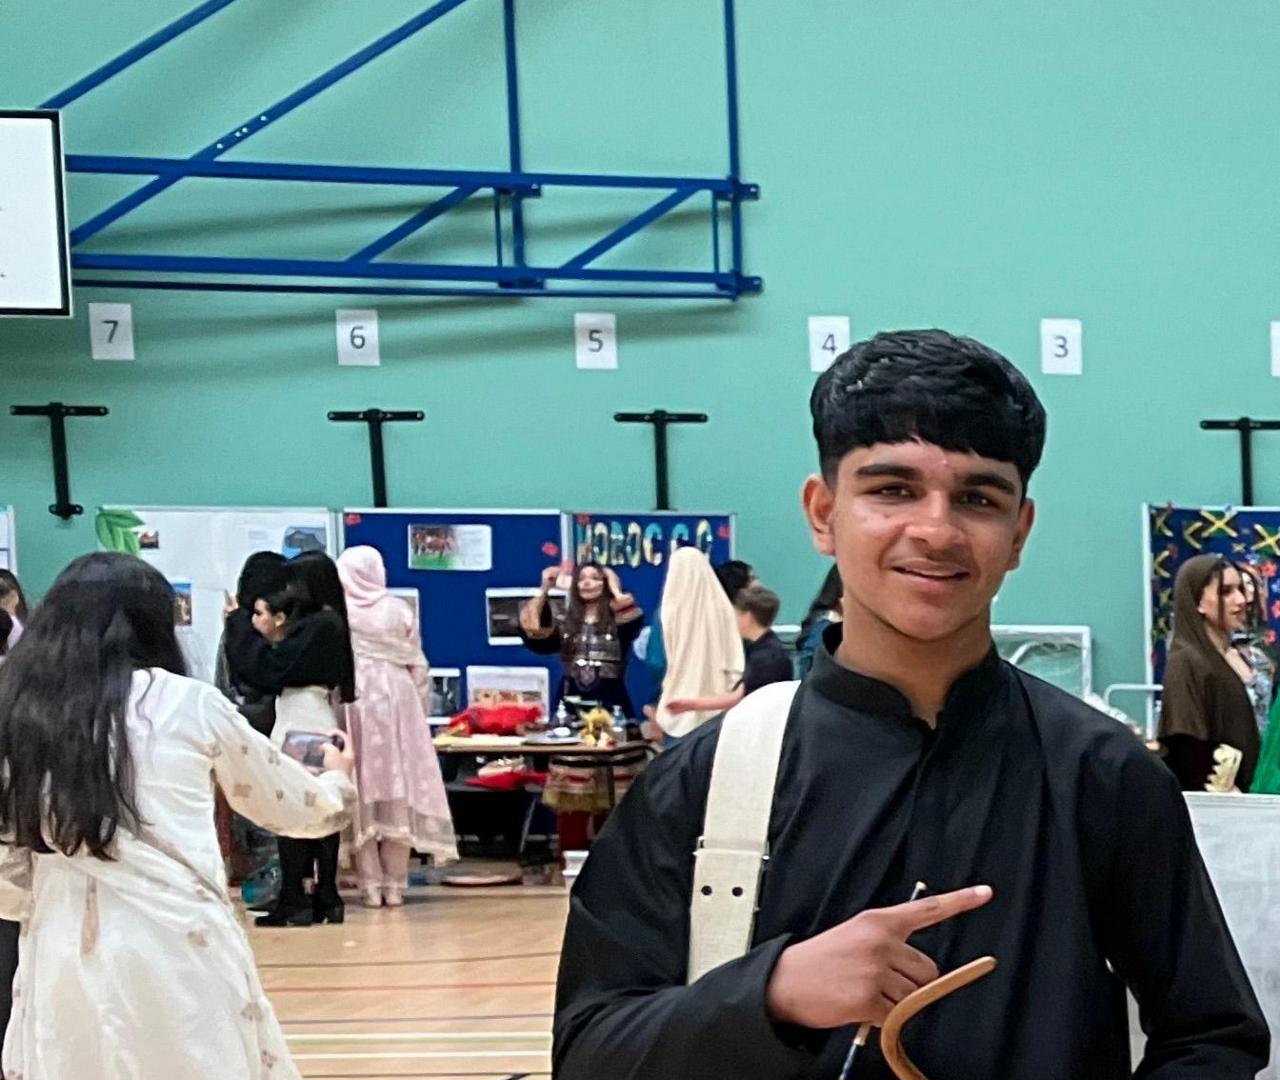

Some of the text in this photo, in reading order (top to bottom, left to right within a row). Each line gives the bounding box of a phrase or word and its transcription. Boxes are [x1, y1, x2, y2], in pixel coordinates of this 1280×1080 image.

[102, 319, 119, 344] 7
[350, 326, 366, 350] 6
[588, 328, 603, 352] 5
[822, 333, 838, 355] 4
[1054, 335, 1069, 358] 3
